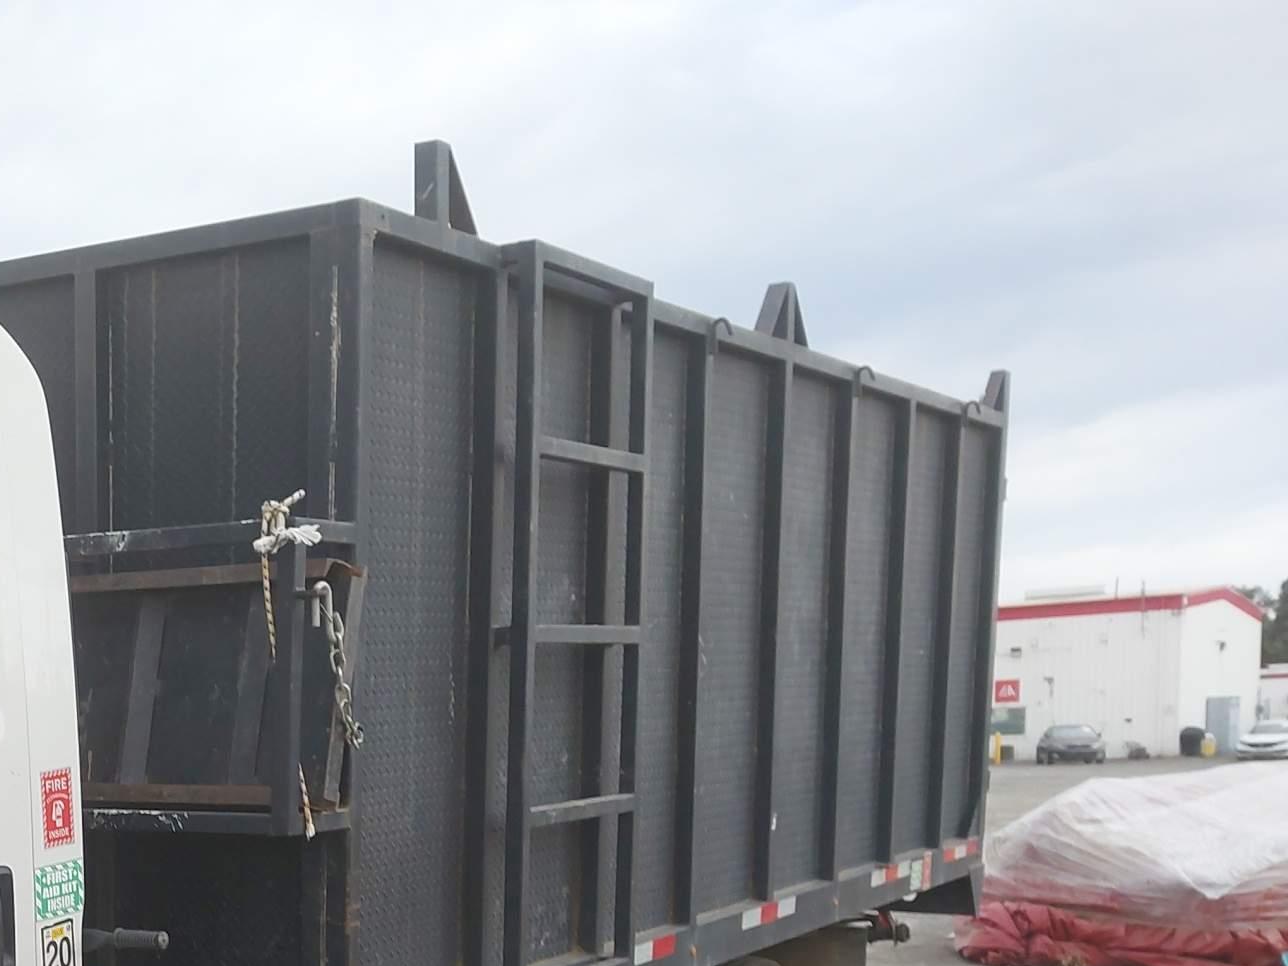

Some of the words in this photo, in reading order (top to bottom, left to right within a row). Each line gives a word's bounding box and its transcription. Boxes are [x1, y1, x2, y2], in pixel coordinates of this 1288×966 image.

[46, 777, 67, 793] FIRE
[48, 827, 70, 840] INSIDE
[46, 869, 72, 886] FIRST
[42, 886, 61, 900] AID
[61, 880, 77, 896] KIT
[47, 893, 75, 912] INSIDE
